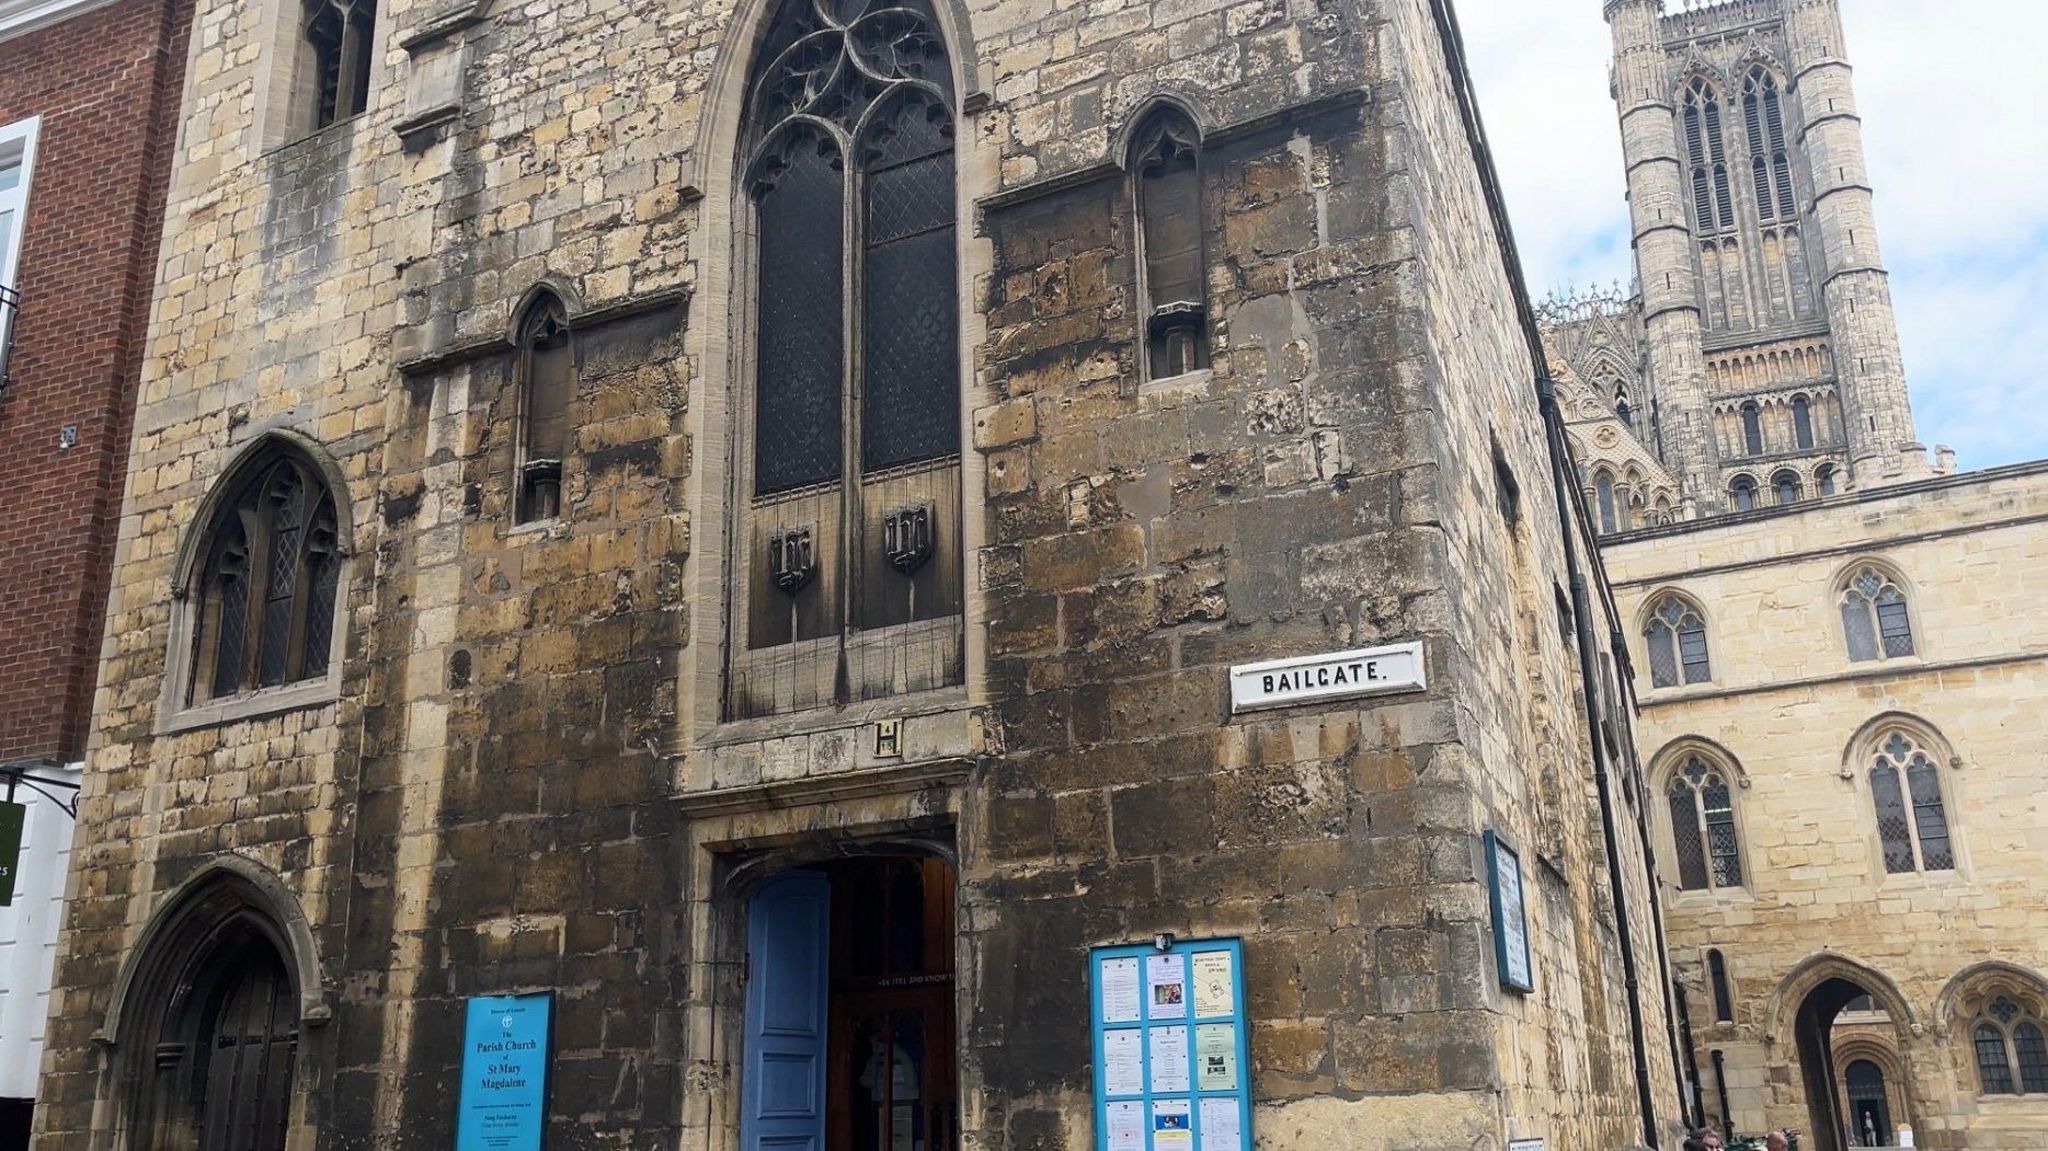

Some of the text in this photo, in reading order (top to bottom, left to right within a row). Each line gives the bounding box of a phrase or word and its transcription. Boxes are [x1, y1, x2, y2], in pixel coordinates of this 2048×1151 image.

[877, 722, 898, 755] H
[477, 1039, 536, 1054] Parish Church
[488, 1064, 521, 1076] St Mary
[481, 1078, 526, 1091] Magdalene
